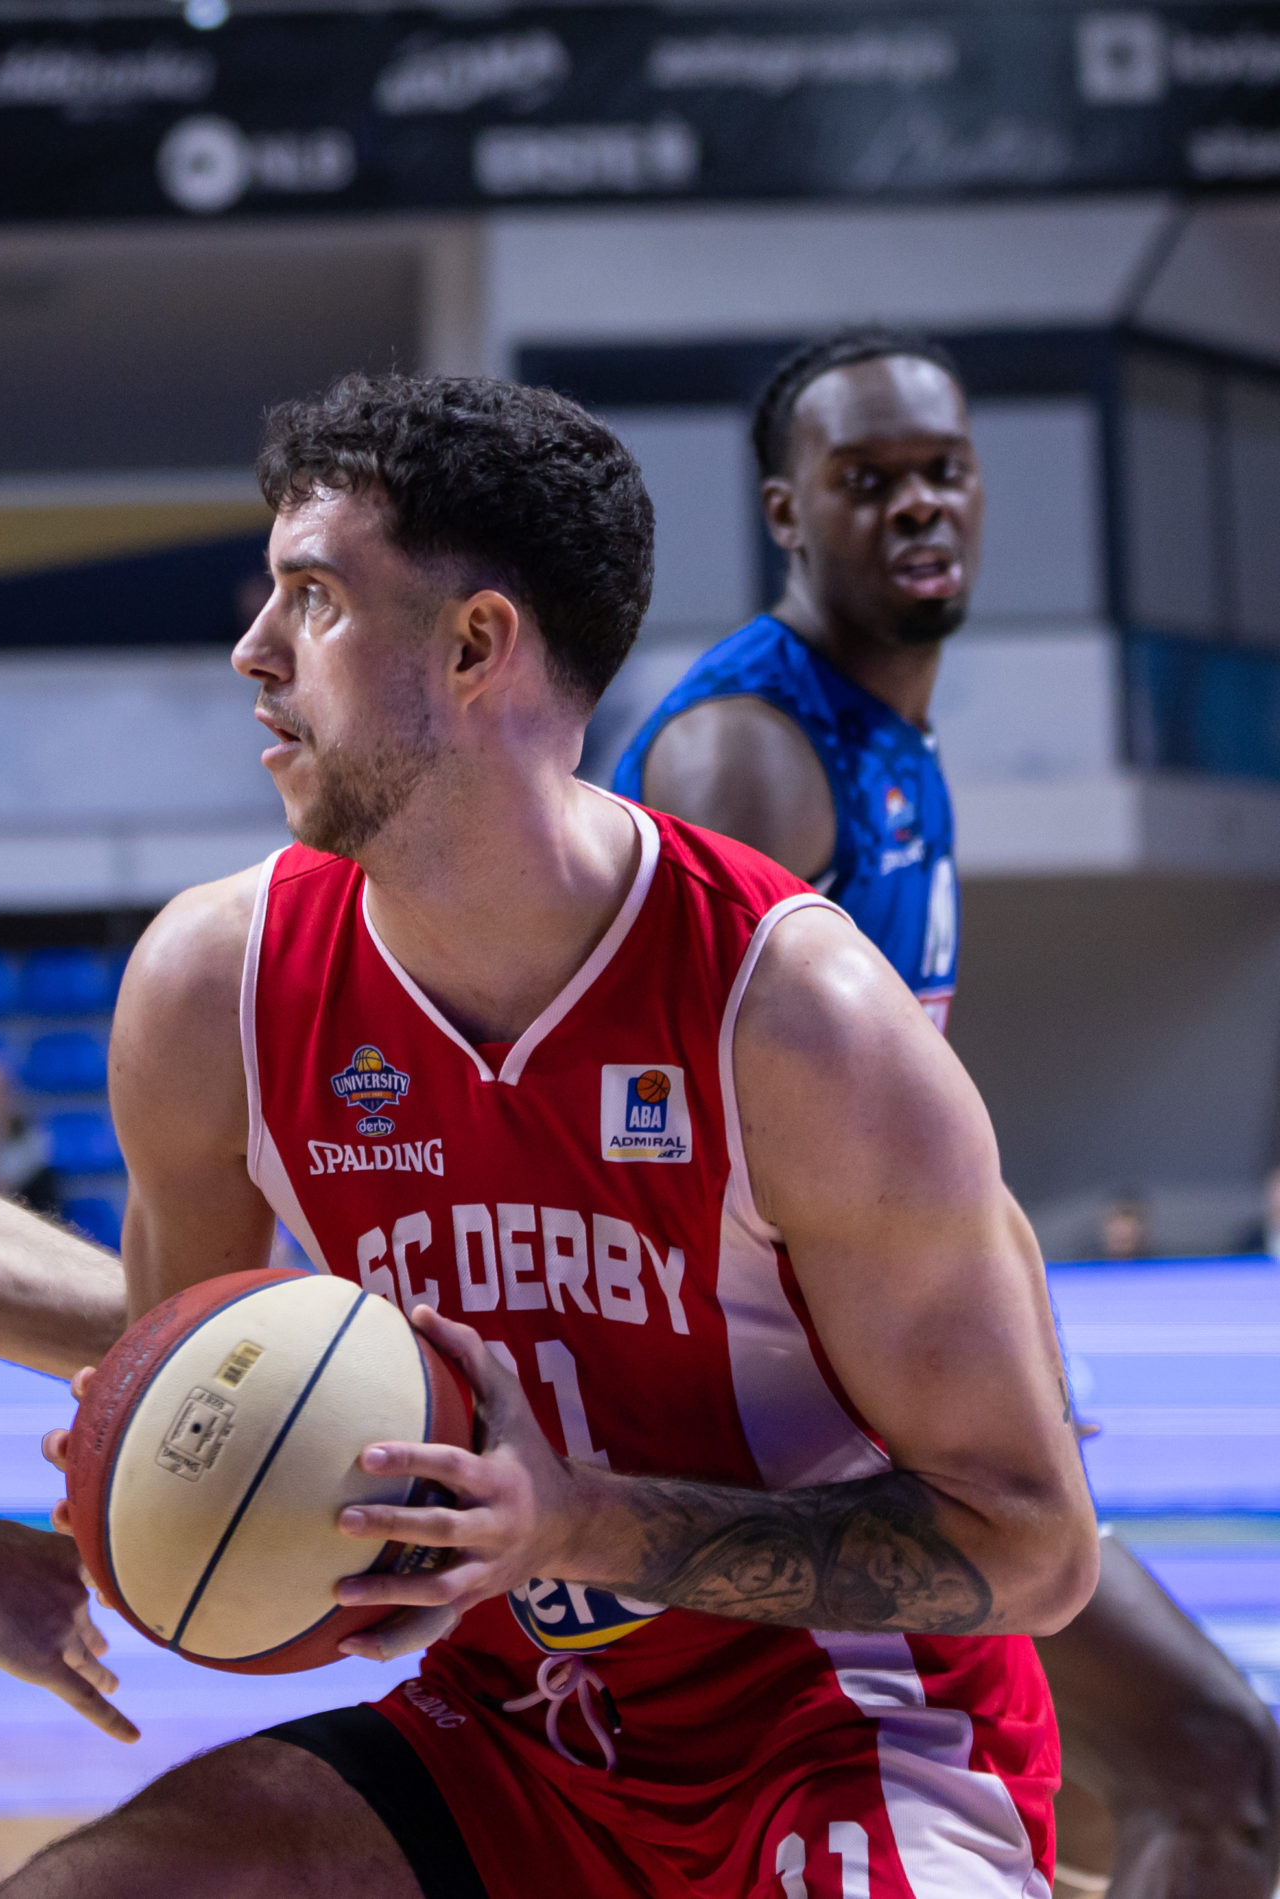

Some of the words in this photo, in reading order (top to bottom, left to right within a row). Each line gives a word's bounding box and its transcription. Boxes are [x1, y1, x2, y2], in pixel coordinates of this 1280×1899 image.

[334, 1072, 409, 1095] UNIVERSITY
[358, 1119, 394, 1135] derby
[628, 1105, 663, 1129] ABA
[609, 1135, 687, 1149] ADMIRAL
[307, 1138, 445, 1177] SPALDING
[356, 1210, 441, 1317] SC
[451, 1202, 691, 1336] DERBY
[483, 1338, 612, 1473] 1
